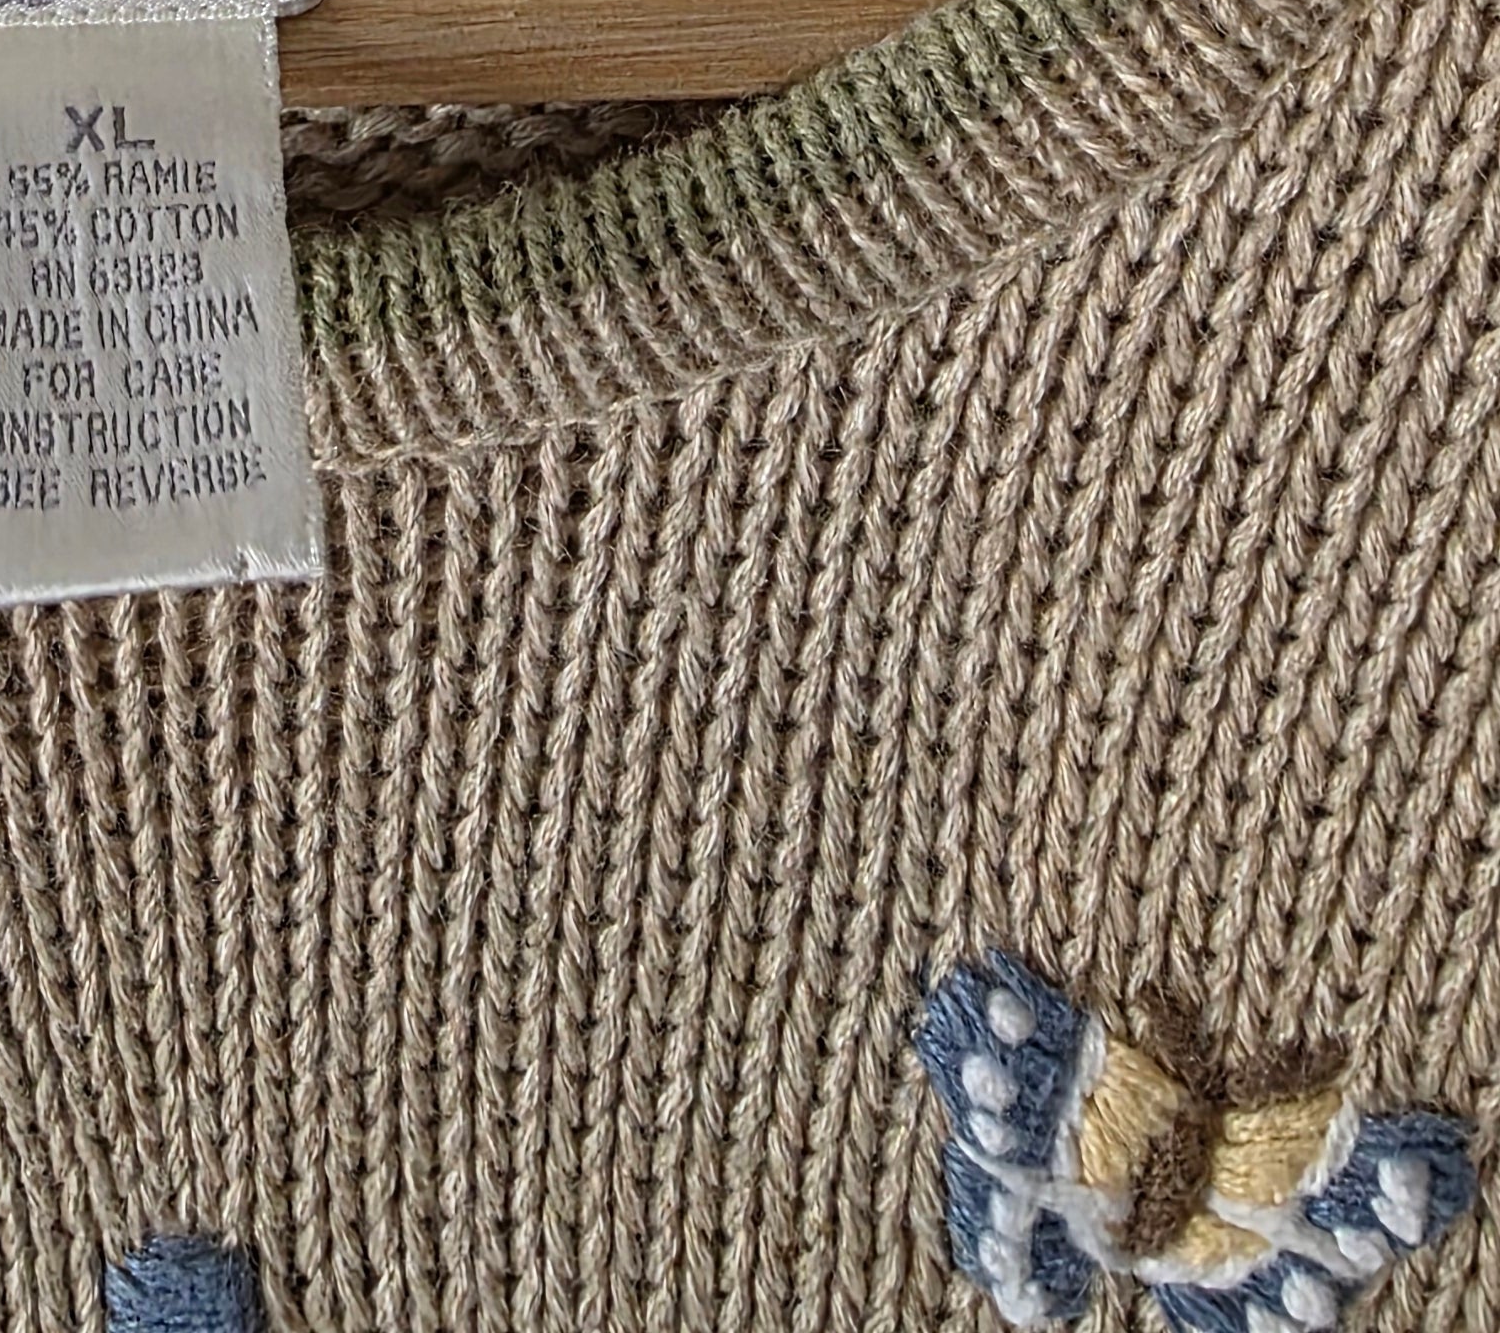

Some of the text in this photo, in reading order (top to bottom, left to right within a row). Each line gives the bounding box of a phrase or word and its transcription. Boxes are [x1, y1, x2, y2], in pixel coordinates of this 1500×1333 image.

[64, 106, 156, 153] XL
[8, 157, 217, 198] 55% RAMIE
[90, 203, 240, 245] COTTON
[31, 258, 75, 300] RN
[97, 306, 131, 350] IN
[143, 294, 259, 345] CHINA
[22, 350, 222, 401] FOR CARE
[90, 445, 267, 511] REVERSE
